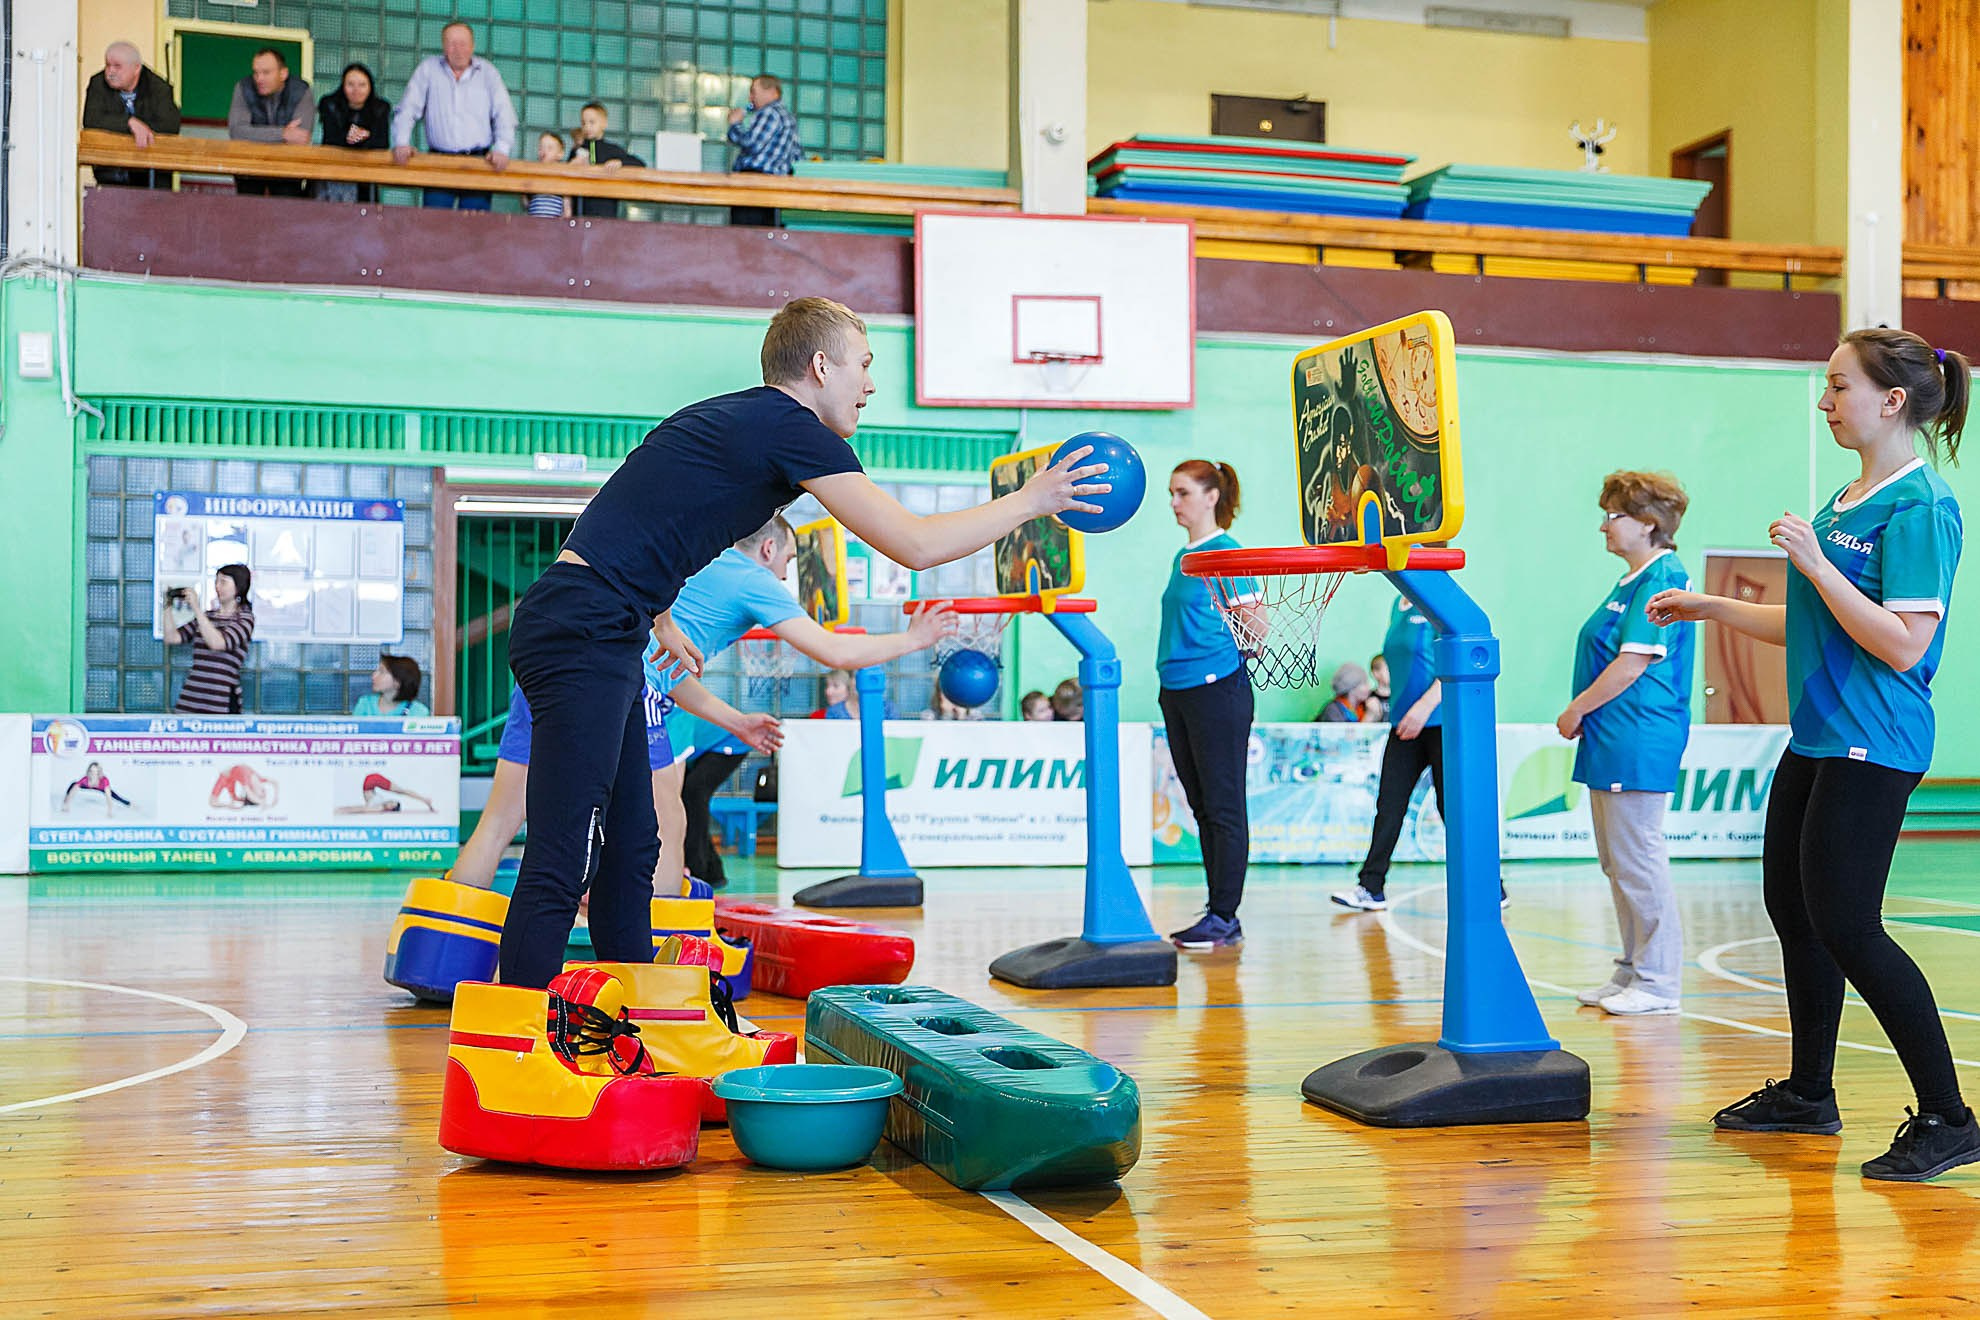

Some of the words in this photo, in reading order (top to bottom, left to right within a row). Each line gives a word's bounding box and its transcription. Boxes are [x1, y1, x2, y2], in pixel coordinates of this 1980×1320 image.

[204, 496, 355, 519] ИНФОРМАЦИЯ
[1827, 529, 1874, 555] СУДЬЯ
[94, 739, 210, 752] ТАНЦЕВАЛЬНАЯ
[212, 740, 307, 753] ГИМНАСТИКА
[308, 741, 340, 754] ДЛЯ
[342, 740, 389, 754] ДЕТЕЙ
[392, 741, 411, 753] ОТ
[425, 741, 452, 753] ЛЕТ
[934, 758, 1086, 788] ИЛИМ
[39, 830, 164, 842] СТЕП-АЭРОБИКА
[179, 829, 265, 842] СУСТАВНАЯ
[270, 829, 368, 841] ГИМНАСТИКА
[383, 828, 449, 841] ПИЛАТЕС
[47, 850, 156, 864] ВОСТОЧНЫЙ
[161, 850, 216, 864] ТАНЕЦ
[242, 850, 373, 863] АКВААЭРОБИКА
[399, 850, 441, 861] ЙОГА
